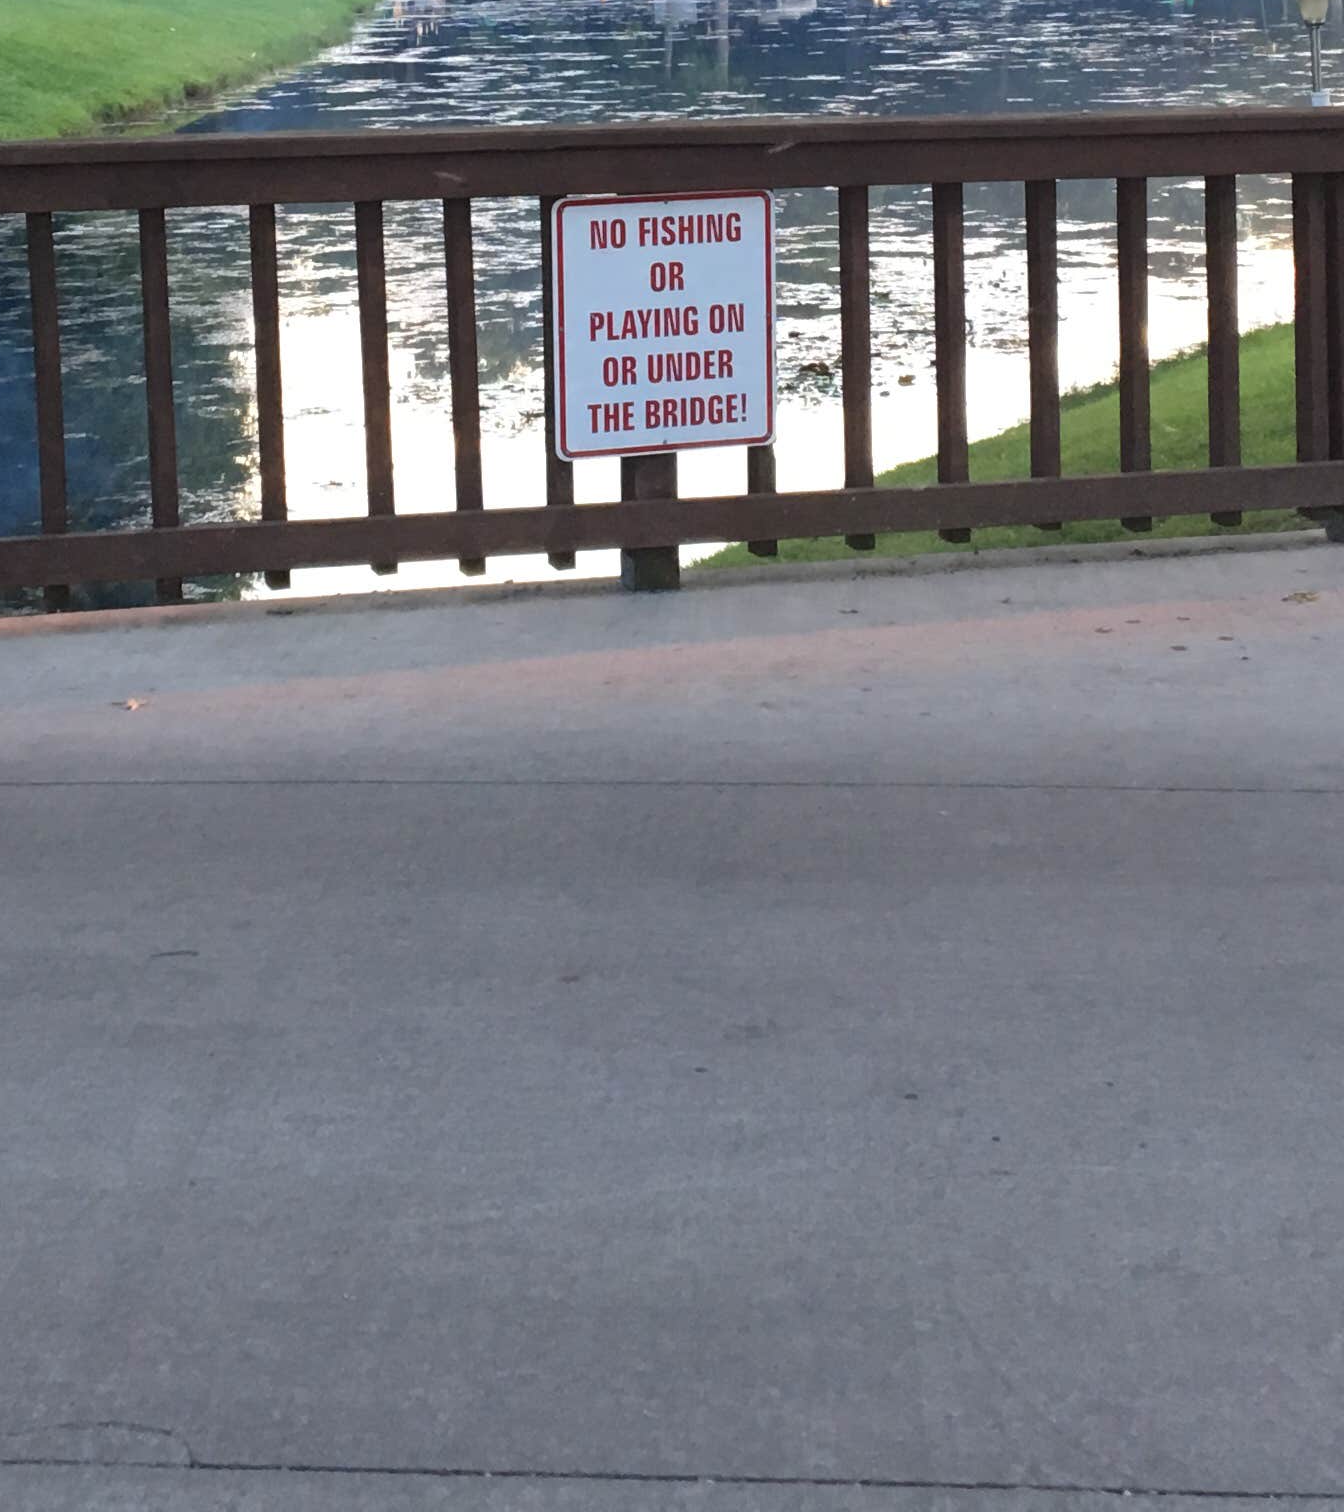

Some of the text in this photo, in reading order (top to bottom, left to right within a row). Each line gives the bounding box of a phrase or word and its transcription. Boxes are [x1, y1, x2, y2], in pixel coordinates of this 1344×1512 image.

[590, 213, 741, 250] NO FISHING
[650, 262, 684, 292] OR
[589, 303, 744, 341] PLAYING ON
[603, 349, 733, 387] OR UNDER
[587, 393, 747, 434] THE BRIDGE!
